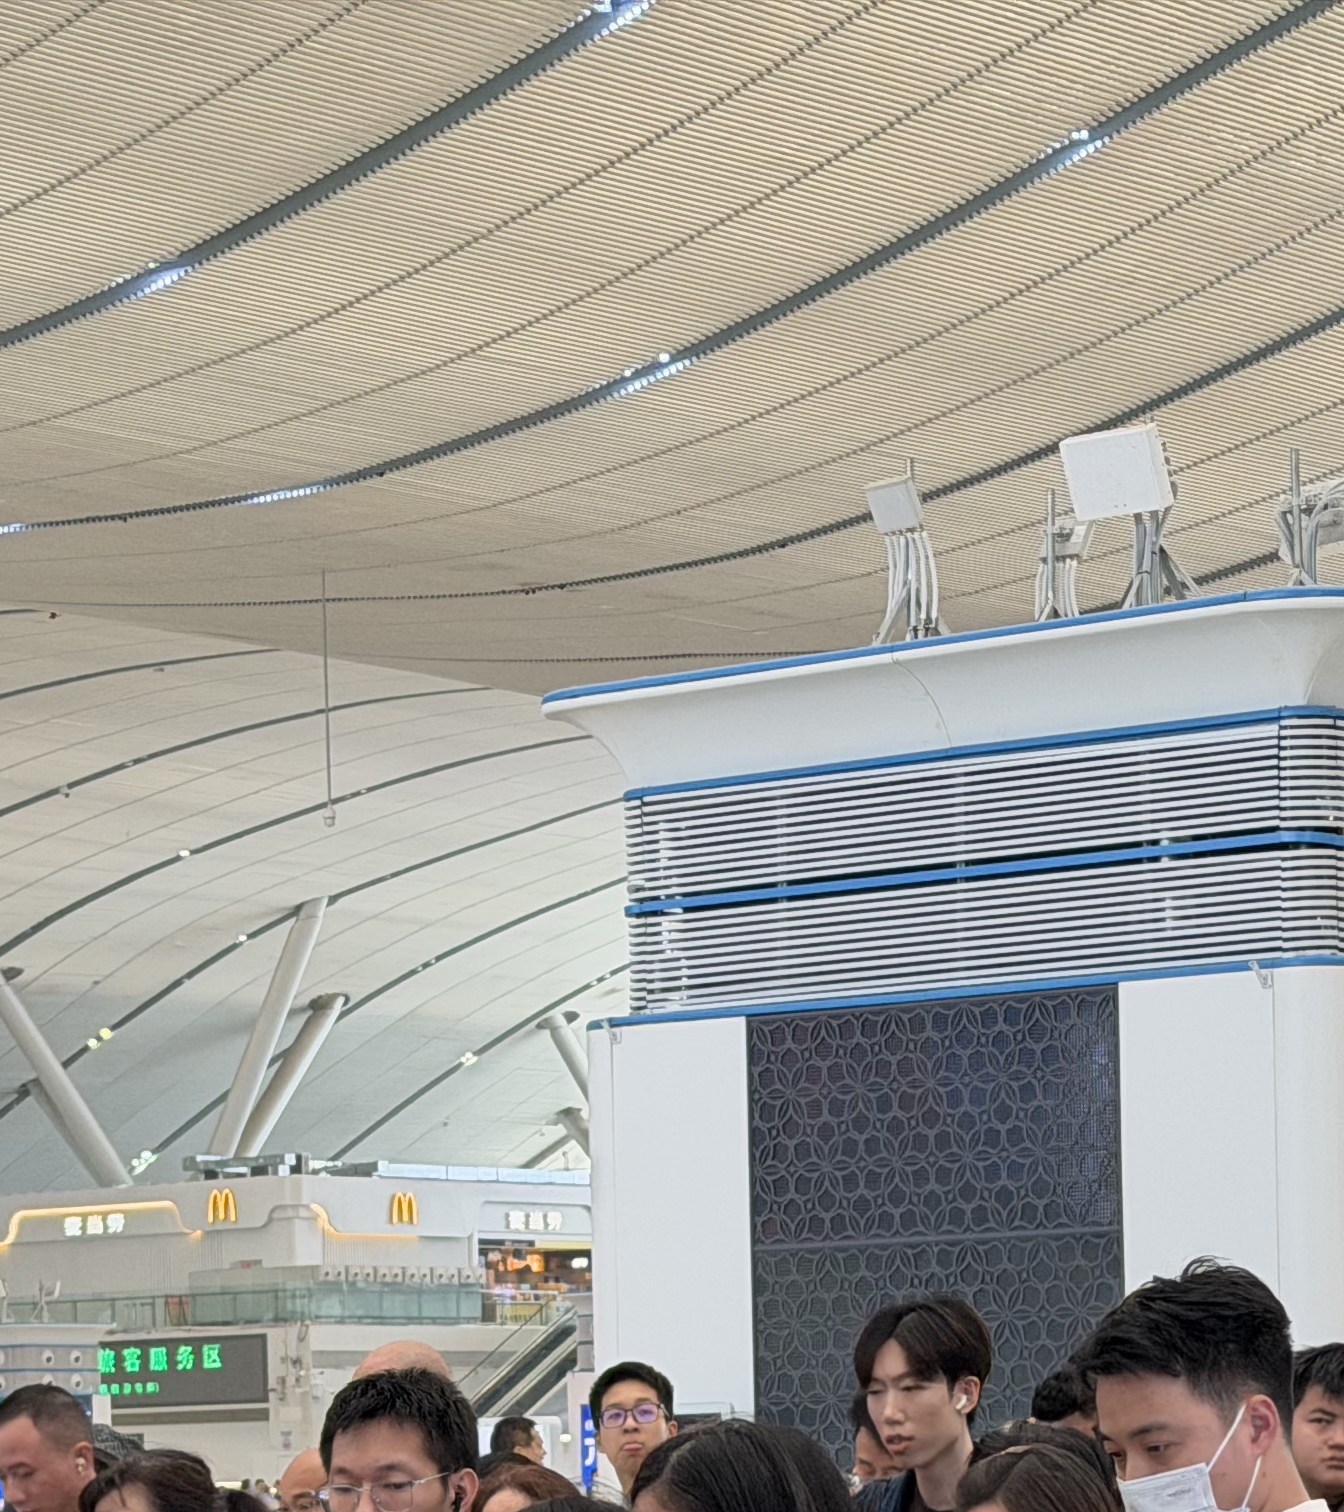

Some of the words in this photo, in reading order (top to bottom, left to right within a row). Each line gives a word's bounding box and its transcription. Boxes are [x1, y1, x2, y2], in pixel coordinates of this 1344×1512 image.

[64, 1213, 125, 1237] 麦当劳
[508, 1210, 563, 1231] 麦当劳
[97, 1344, 223, 1374] 旅客服务区
